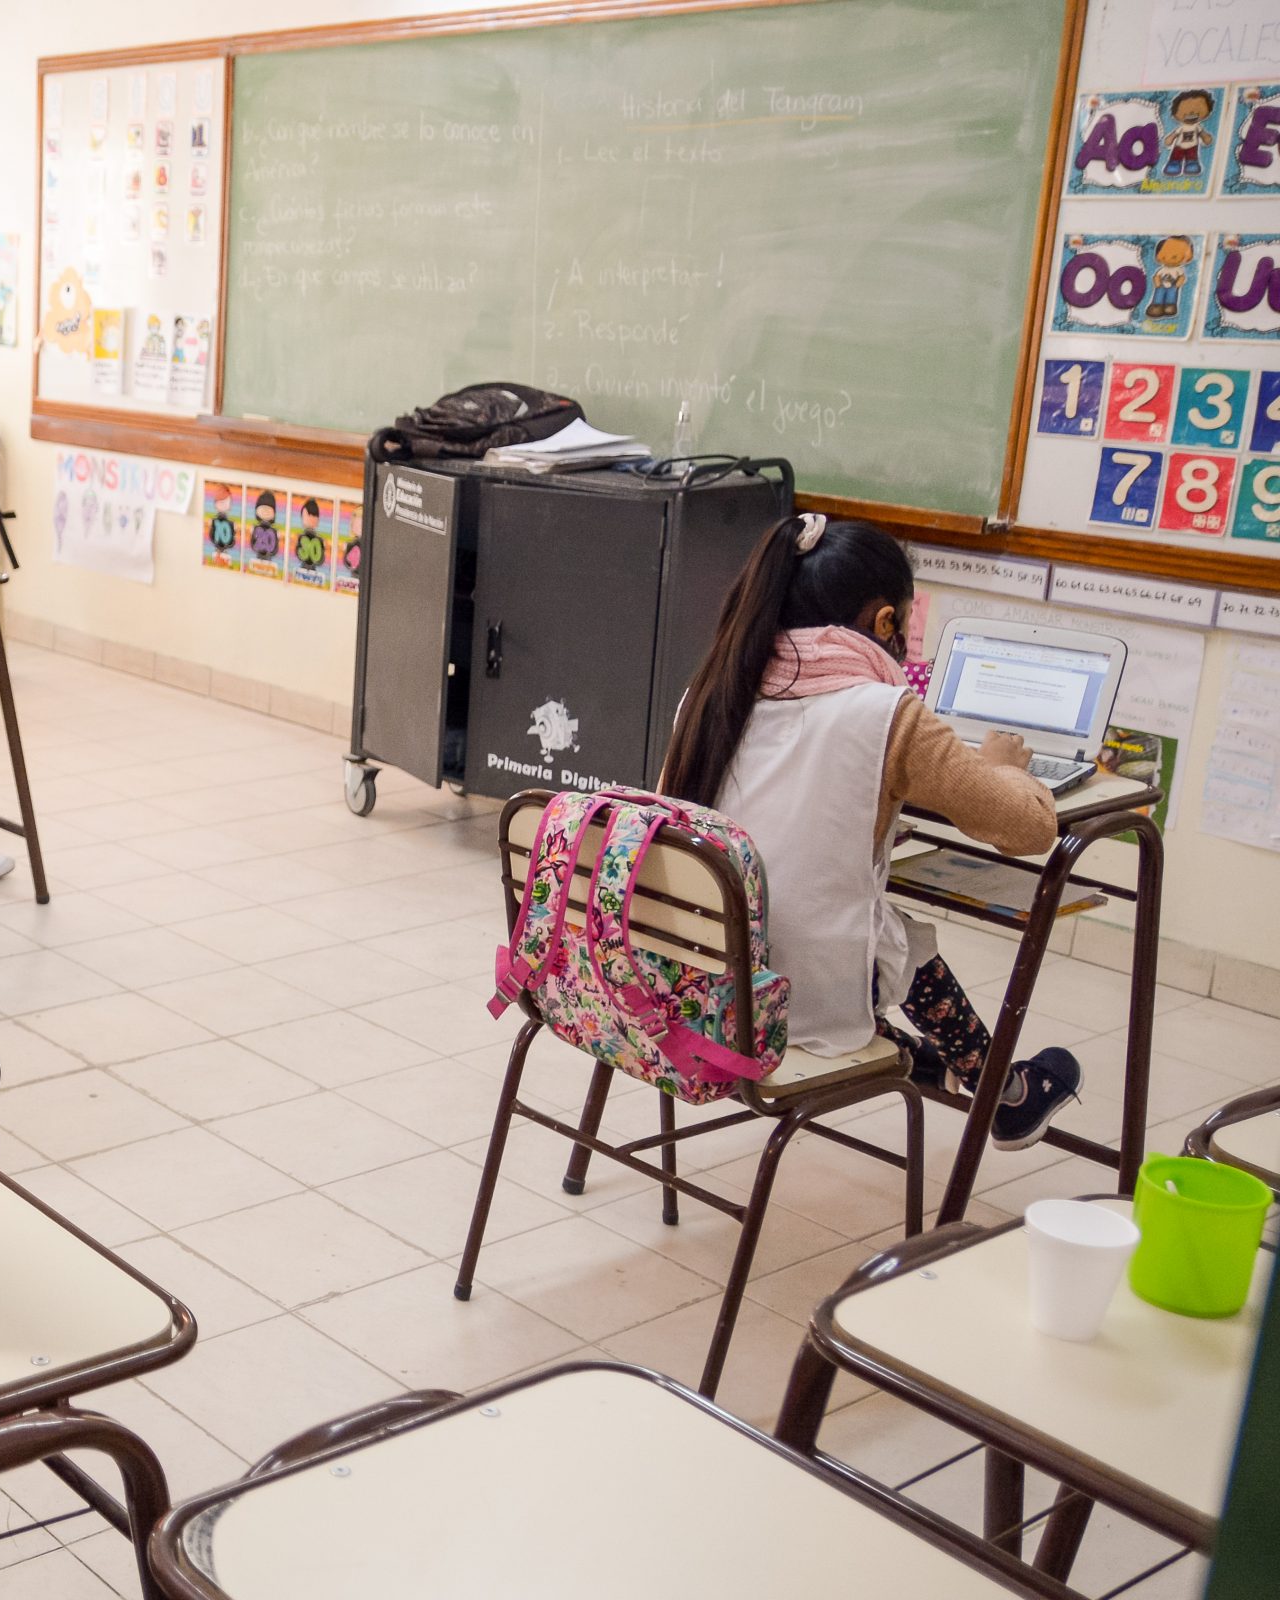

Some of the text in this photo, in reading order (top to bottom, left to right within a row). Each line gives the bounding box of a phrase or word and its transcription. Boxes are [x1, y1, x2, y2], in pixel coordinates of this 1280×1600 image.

[419, 109, 435, 141] lo
[443, 121, 502, 143] conoce
[512, 124, 535, 146] en
[716, 88, 746, 117] del
[762, 86, 864, 131] Tangram
[632, 138, 649, 163] el
[664, 135, 721, 165] texto
[1075, 113, 1160, 172] Aa
[1239, 105, 1280, 168] E
[455, 191, 493, 219] este
[1060, 252, 1147, 310] Oo
[660, 370, 737, 405] inventó
[746, 378, 766, 412] el
[773, 389, 853, 443] juego?
[1059, 364, 1082, 419] 1
[1119, 368, 1160, 423] 2
[1188, 372, 1235, 430] 3
[57, 452, 190, 504] MONSTRUOS
[1112, 451, 1152, 506] 7
[1176, 459, 1219, 513] 8
[1252, 465, 1280, 523] 9
[297, 535, 324, 564] 30
[487, 753, 553, 780] Primaria
